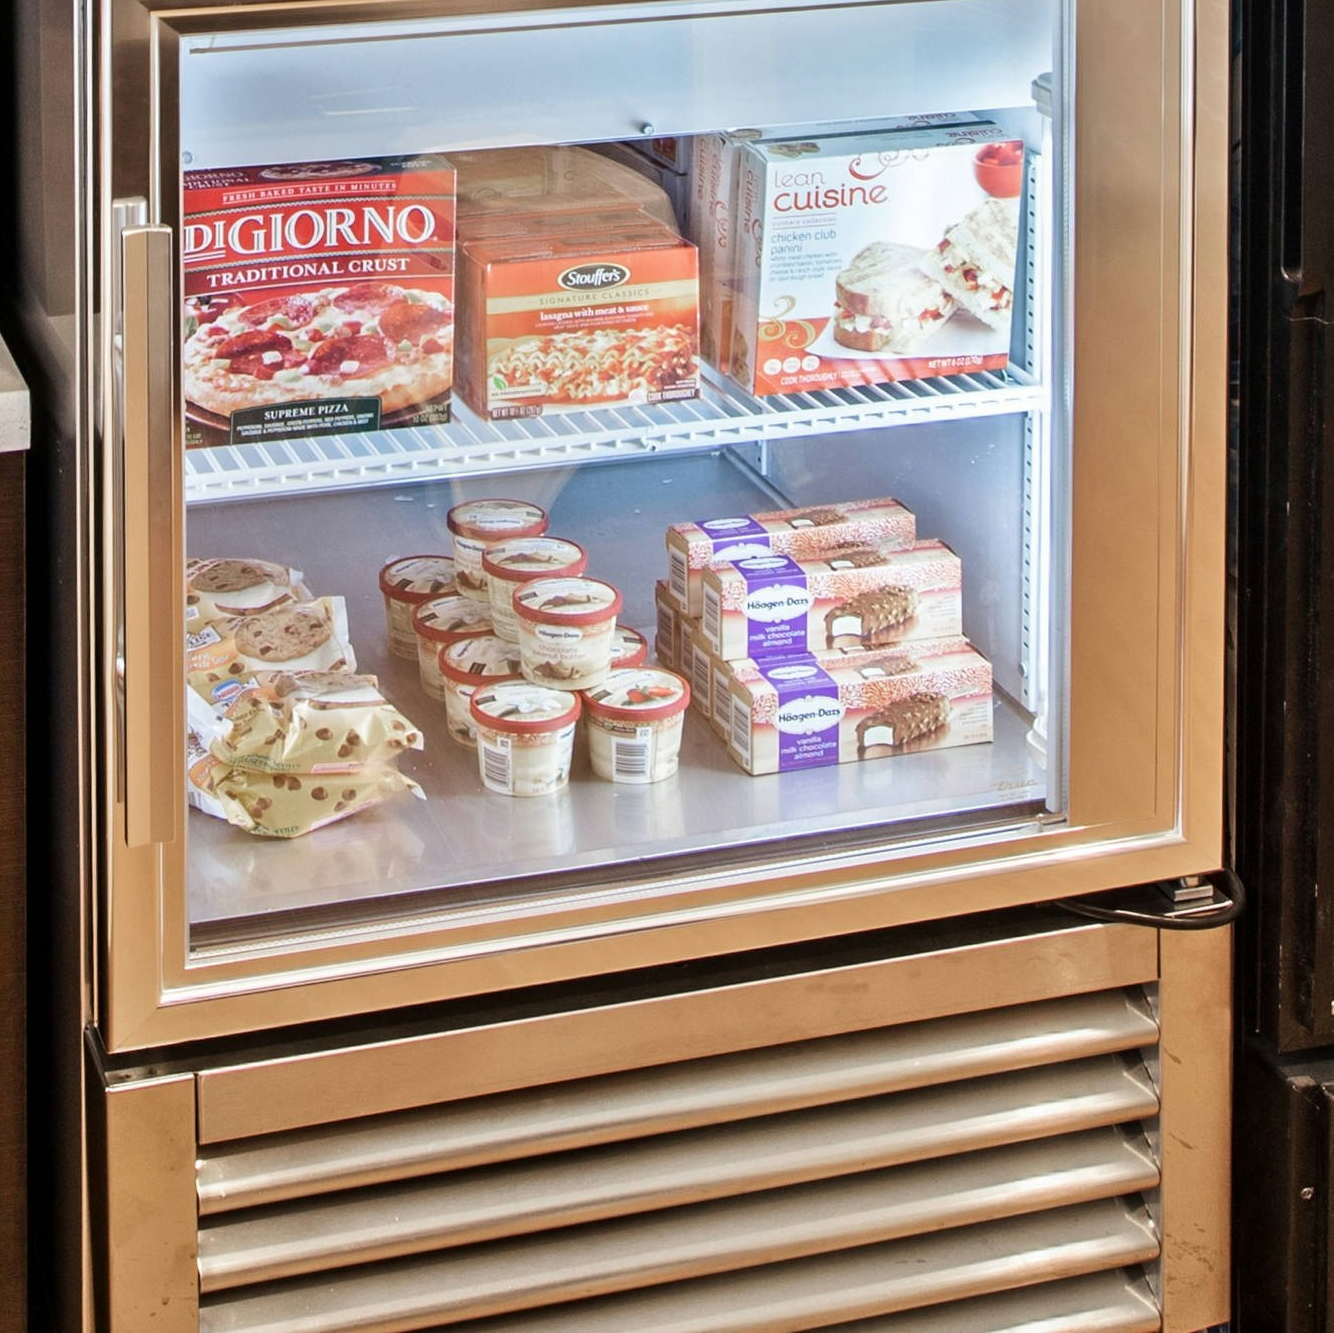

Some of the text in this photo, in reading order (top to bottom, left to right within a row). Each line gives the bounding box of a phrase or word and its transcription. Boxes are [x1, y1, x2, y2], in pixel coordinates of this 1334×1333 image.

[774, 170, 826, 188] lean
[223, 181, 397, 204] FRESH BAKED TASTE IN MINUTES
[773, 183, 889, 213] cuisine
[770, 229, 837, 243] chicken club
[770, 243, 803, 256] panini
[206, 257, 410, 288] TRADITIONAL CRUST
[566, 267, 622, 286] Stouffer's
[538, 288, 650, 306] SIGNATURE CLASSICS
[539, 310, 573, 324] lasagna
[574, 308, 594, 318] with
[595, 306, 616, 316] meat
[626, 304, 650, 313] sauce
[264, 403, 348, 421] SUPREME PIZZA
[765, 624, 791, 633] vanilla
[767, 630, 805, 640] chocolate
[762, 639, 793, 647] almond
